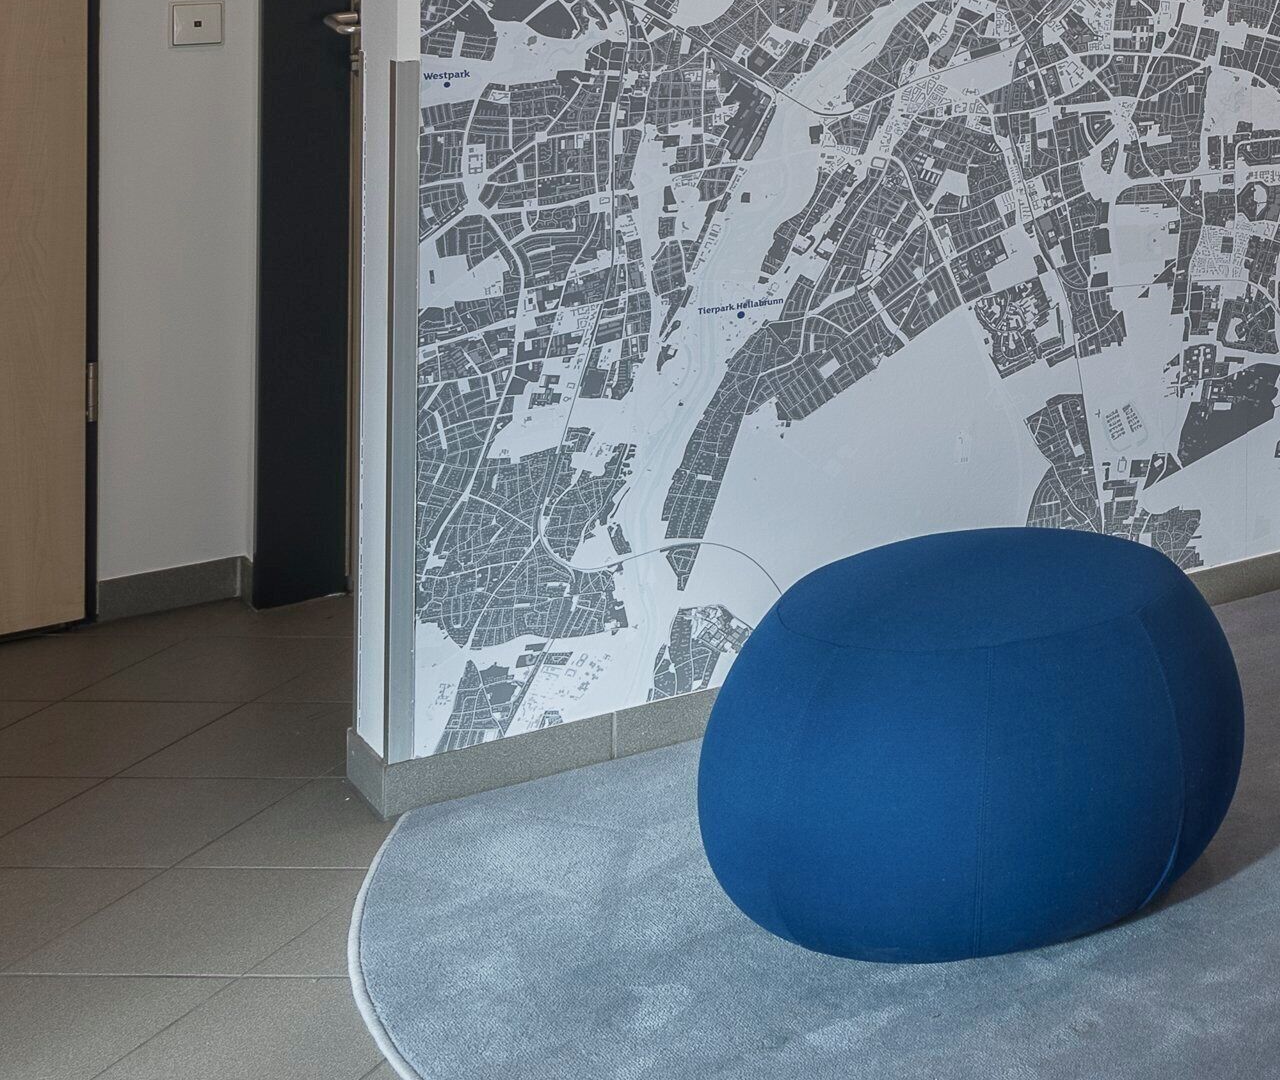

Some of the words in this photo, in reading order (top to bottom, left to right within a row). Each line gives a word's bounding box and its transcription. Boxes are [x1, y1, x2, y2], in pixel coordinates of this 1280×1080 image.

[423, 69, 471, 80] Westpark
[697, 303, 736, 315] Tierpark
[736, 297, 784, 310] Hellabrunn
